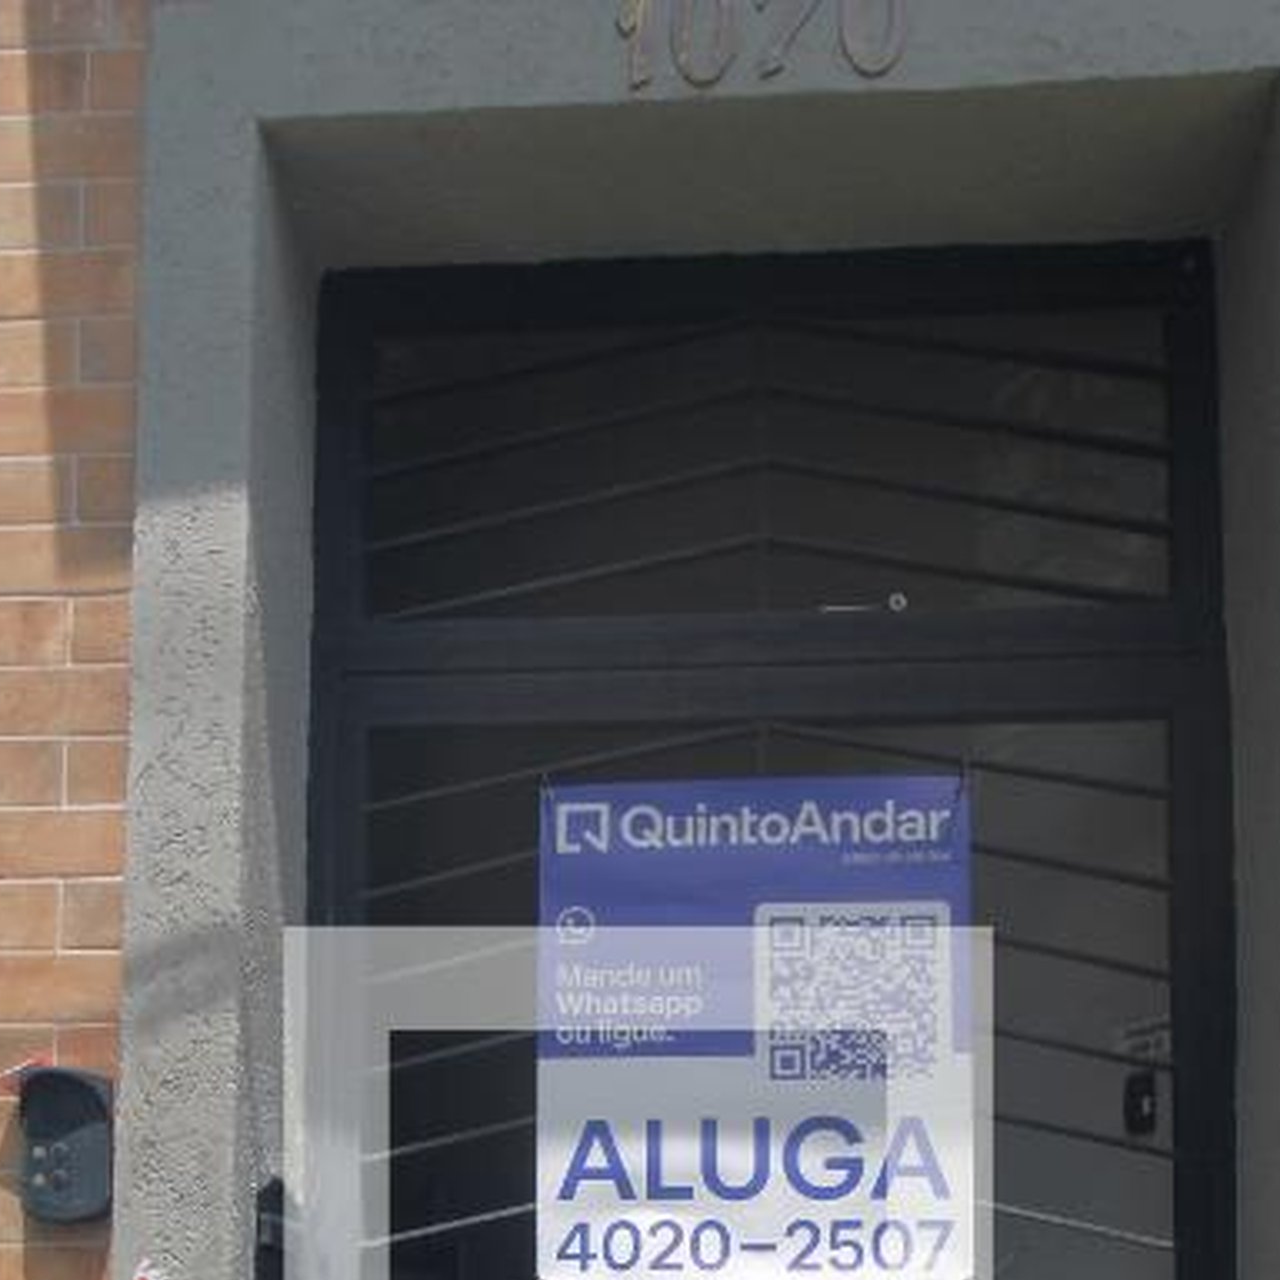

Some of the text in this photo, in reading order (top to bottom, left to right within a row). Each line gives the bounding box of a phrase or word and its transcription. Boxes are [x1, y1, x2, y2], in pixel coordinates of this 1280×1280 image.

[620, 800, 951, 850] QuintoAndar
[556, 991, 704, 1020] Whatsapp
[556, 1024, 591, 1046] ou
[556, 1115, 952, 1202] ALUGA
[556, 1217, 957, 1273] 4020-2507
